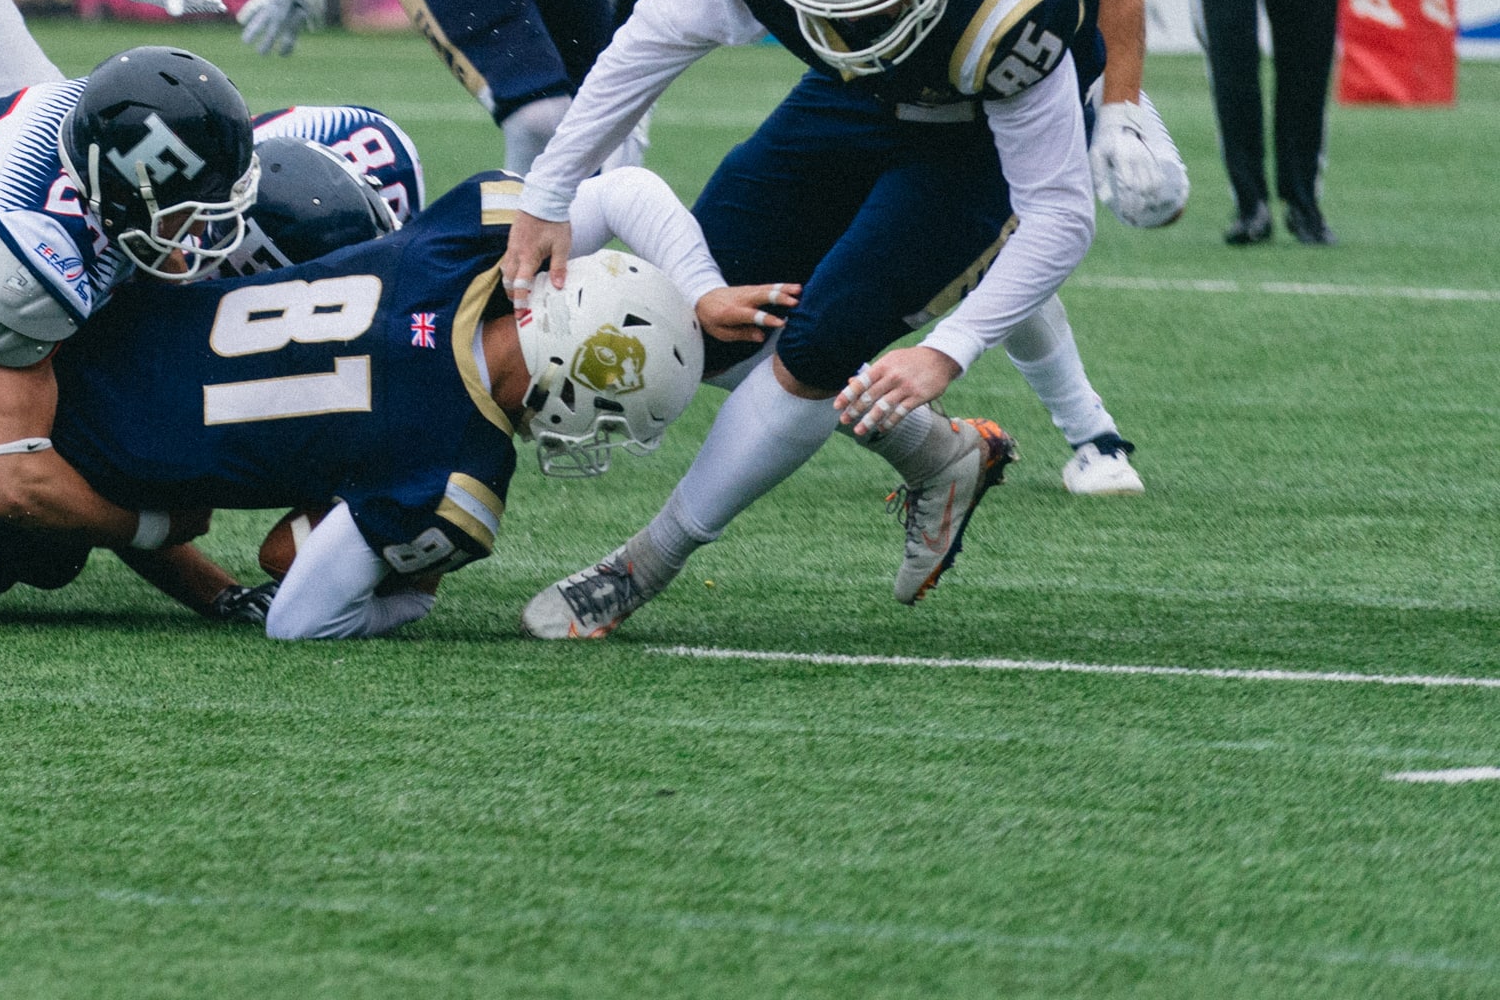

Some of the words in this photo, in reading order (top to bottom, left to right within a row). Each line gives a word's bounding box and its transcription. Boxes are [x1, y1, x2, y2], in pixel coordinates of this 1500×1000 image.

[986, 21, 1064, 96] 85
[106, 113, 206, 188] F
[203, 274, 383, 426] 81
